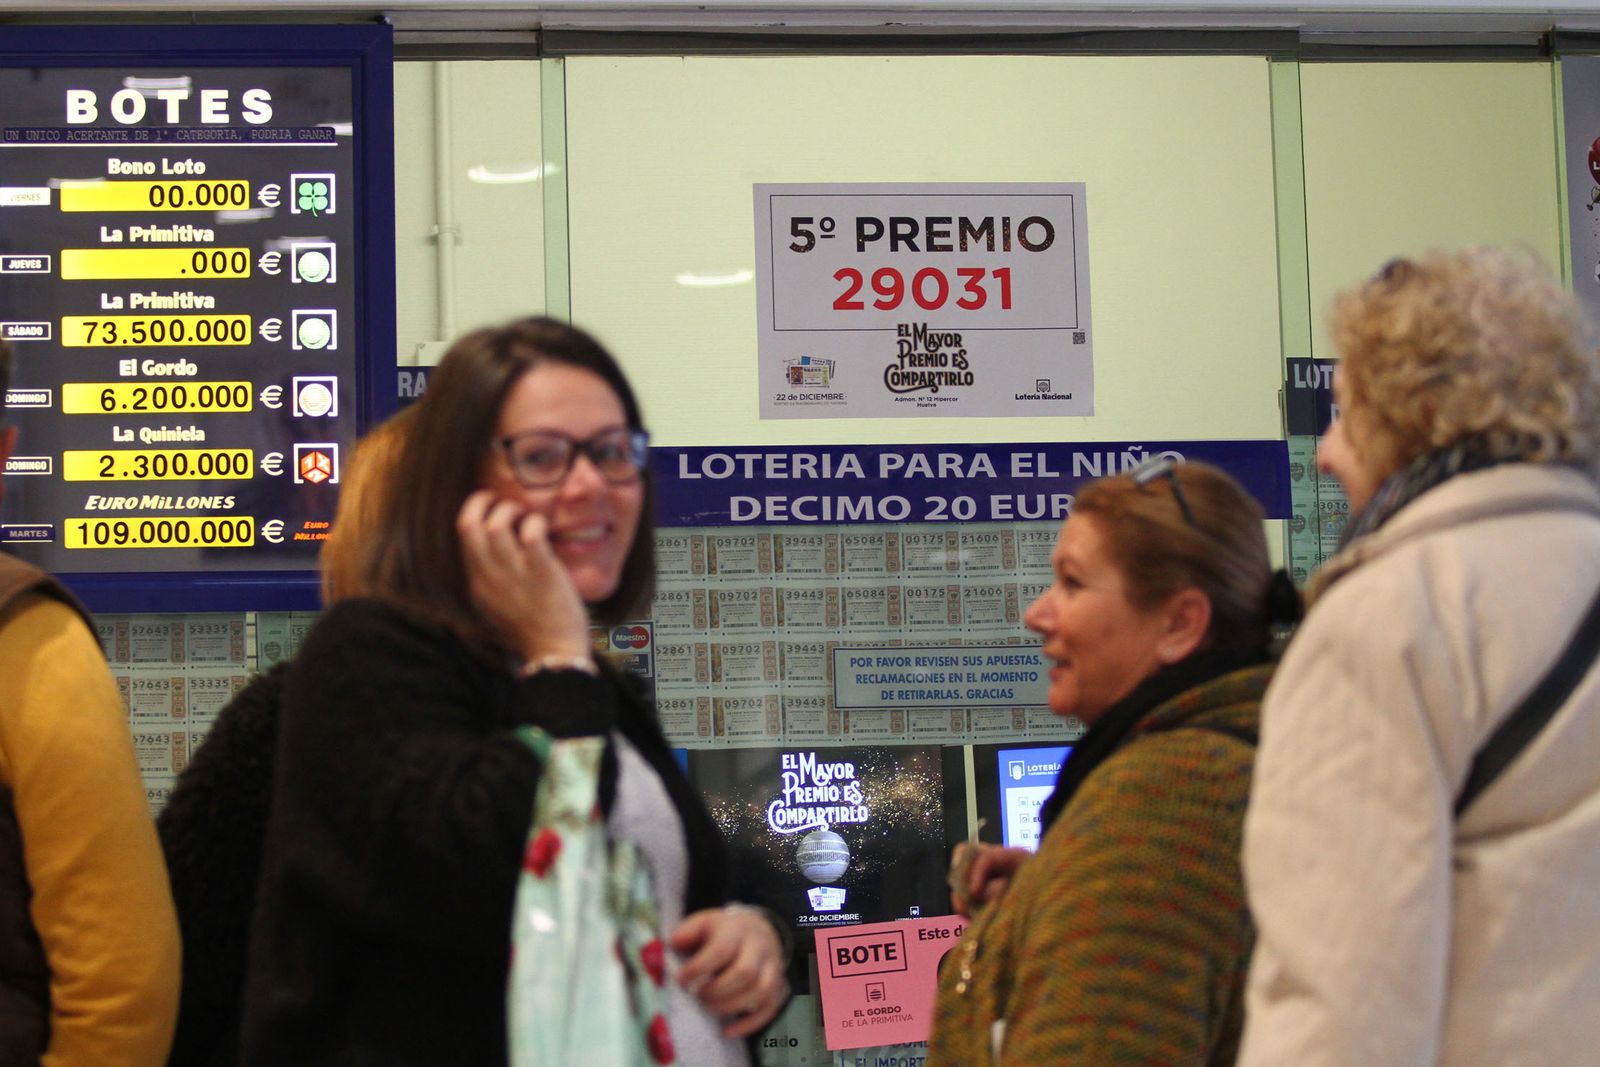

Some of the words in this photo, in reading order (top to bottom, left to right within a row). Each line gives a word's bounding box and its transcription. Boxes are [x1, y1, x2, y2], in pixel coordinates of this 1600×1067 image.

[66, 88, 273, 125] BOTES
[5, 130, 19, 141] UN
[26, 130, 60, 141] UNICO
[66, 130, 128, 141] ACERTANTE
[135, 130, 149, 140] DE
[252, 129, 292, 140] PODRIA
[298, 129, 333, 140] GANAR
[108, 158, 156, 174] Bono
[162, 158, 206, 174] Loto
[101, 226, 123, 242] La
[129, 225, 215, 242] Primitiva
[856, 215, 1056, 253] PREMIO
[8, 259, 42, 269] JUEVES
[832, 267, 1012, 311] 29031
[101, 293, 123, 309] La
[130, 292, 215, 309] Primitiva
[83, 319, 246, 344] 73.500.000
[897, 323, 912, 337] EL
[119, 359, 137, 376] El
[142, 358, 198, 376] Gordo
[1294, 363, 1334, 389] LOT
[5, 393, 47, 403] DOMINGO
[100, 385, 248, 411] 6.200.000
[787, 393, 798, 401] de
[799, 393, 844, 401] DICIEMBRE
[113, 426, 134, 442] La
[139, 425, 205, 444] Quiniela
[5, 460, 47, 471] DOMINGO
[99, 452, 248, 478] 2.300.000
[679, 453, 866, 479] LOTERIA
[879, 452, 998, 478] PARA
[1010, 452, 1060, 478] EL
[730, 495, 912, 521] DECIMO
[924, 495, 977, 521] 20
[990, 494, 1076, 519] EUR
[9, 530, 48, 538] MARTES
[78, 519, 252, 545] 109.000.000
[850, 657, 874, 668] POR
[876, 656, 912, 667] FAVOR
[915, 656, 960, 667] REVISEN
[962, 656, 984, 666] SUS
[986, 655, 1043, 666] APUESTAS.
[856, 673, 946, 684] RECLAMACIONES
[949, 673, 963, 683] EN
[966, 673, 978, 683] EL
[980, 672, 1038, 683] MOMENTO
[881, 690, 895, 701] DE
[898, 689, 963, 700] RETIRARLAS.
[966, 688, 1014, 699] GRACIAS
[781, 754, 799, 769] EL
[819, 913, 860, 921] DICIEMBRE
[918, 927, 951, 941] Este
[953, 924, 967, 938] d
[836, 942, 898, 966] BOTE
[854, 1008, 864, 1018] EL
[866, 1005, 902, 1016] GORDO
[842, 1020, 855, 1029] DE
[857, 1018, 869, 1027] LA
[871, 1013, 914, 1025] PRIMITIVA
[875, 1057, 926, 1067] IMPORT
